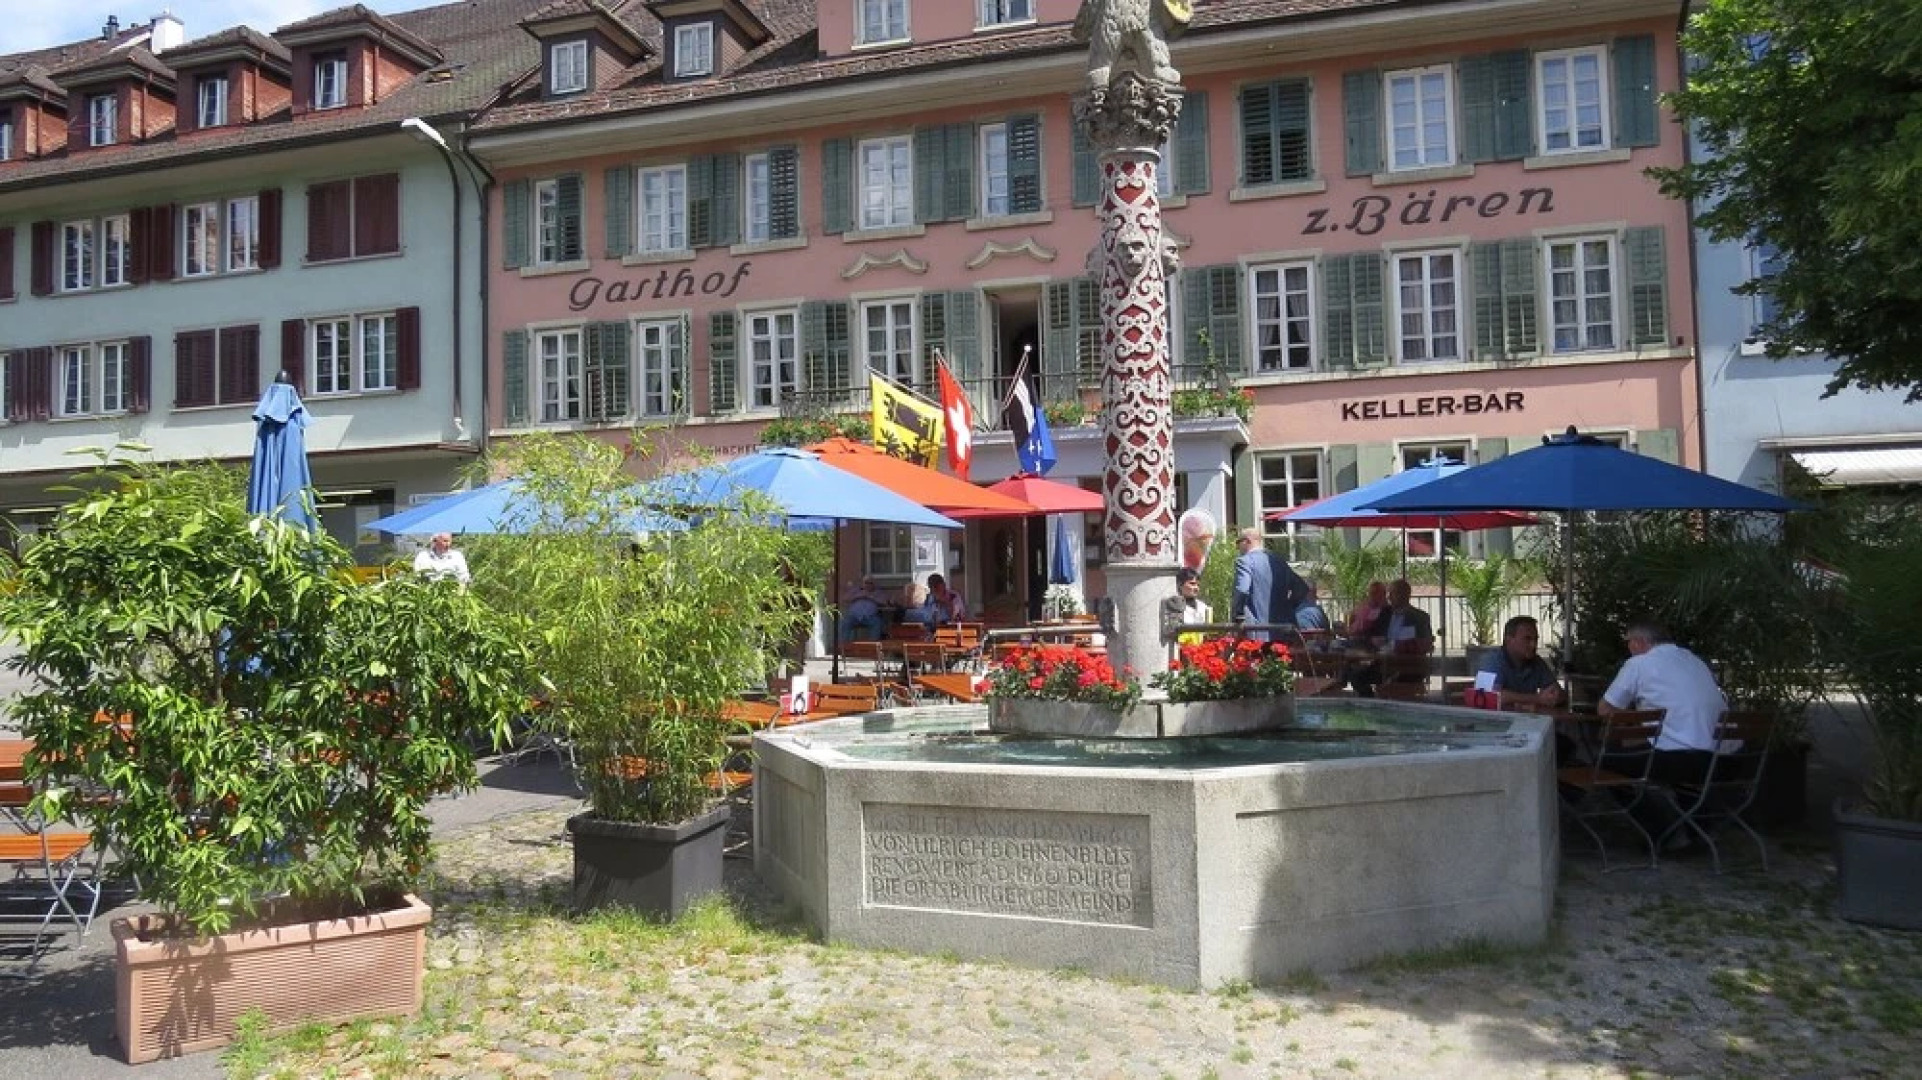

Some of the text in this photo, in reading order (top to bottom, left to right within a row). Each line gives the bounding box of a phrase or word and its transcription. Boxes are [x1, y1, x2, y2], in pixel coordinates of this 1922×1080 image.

[569, 262, 751, 311] Gasthof
[1342, 392, 1524, 421] KELLER-BAR
[869, 834, 913, 853] VON
[914, 836, 987, 857] ULRICH
